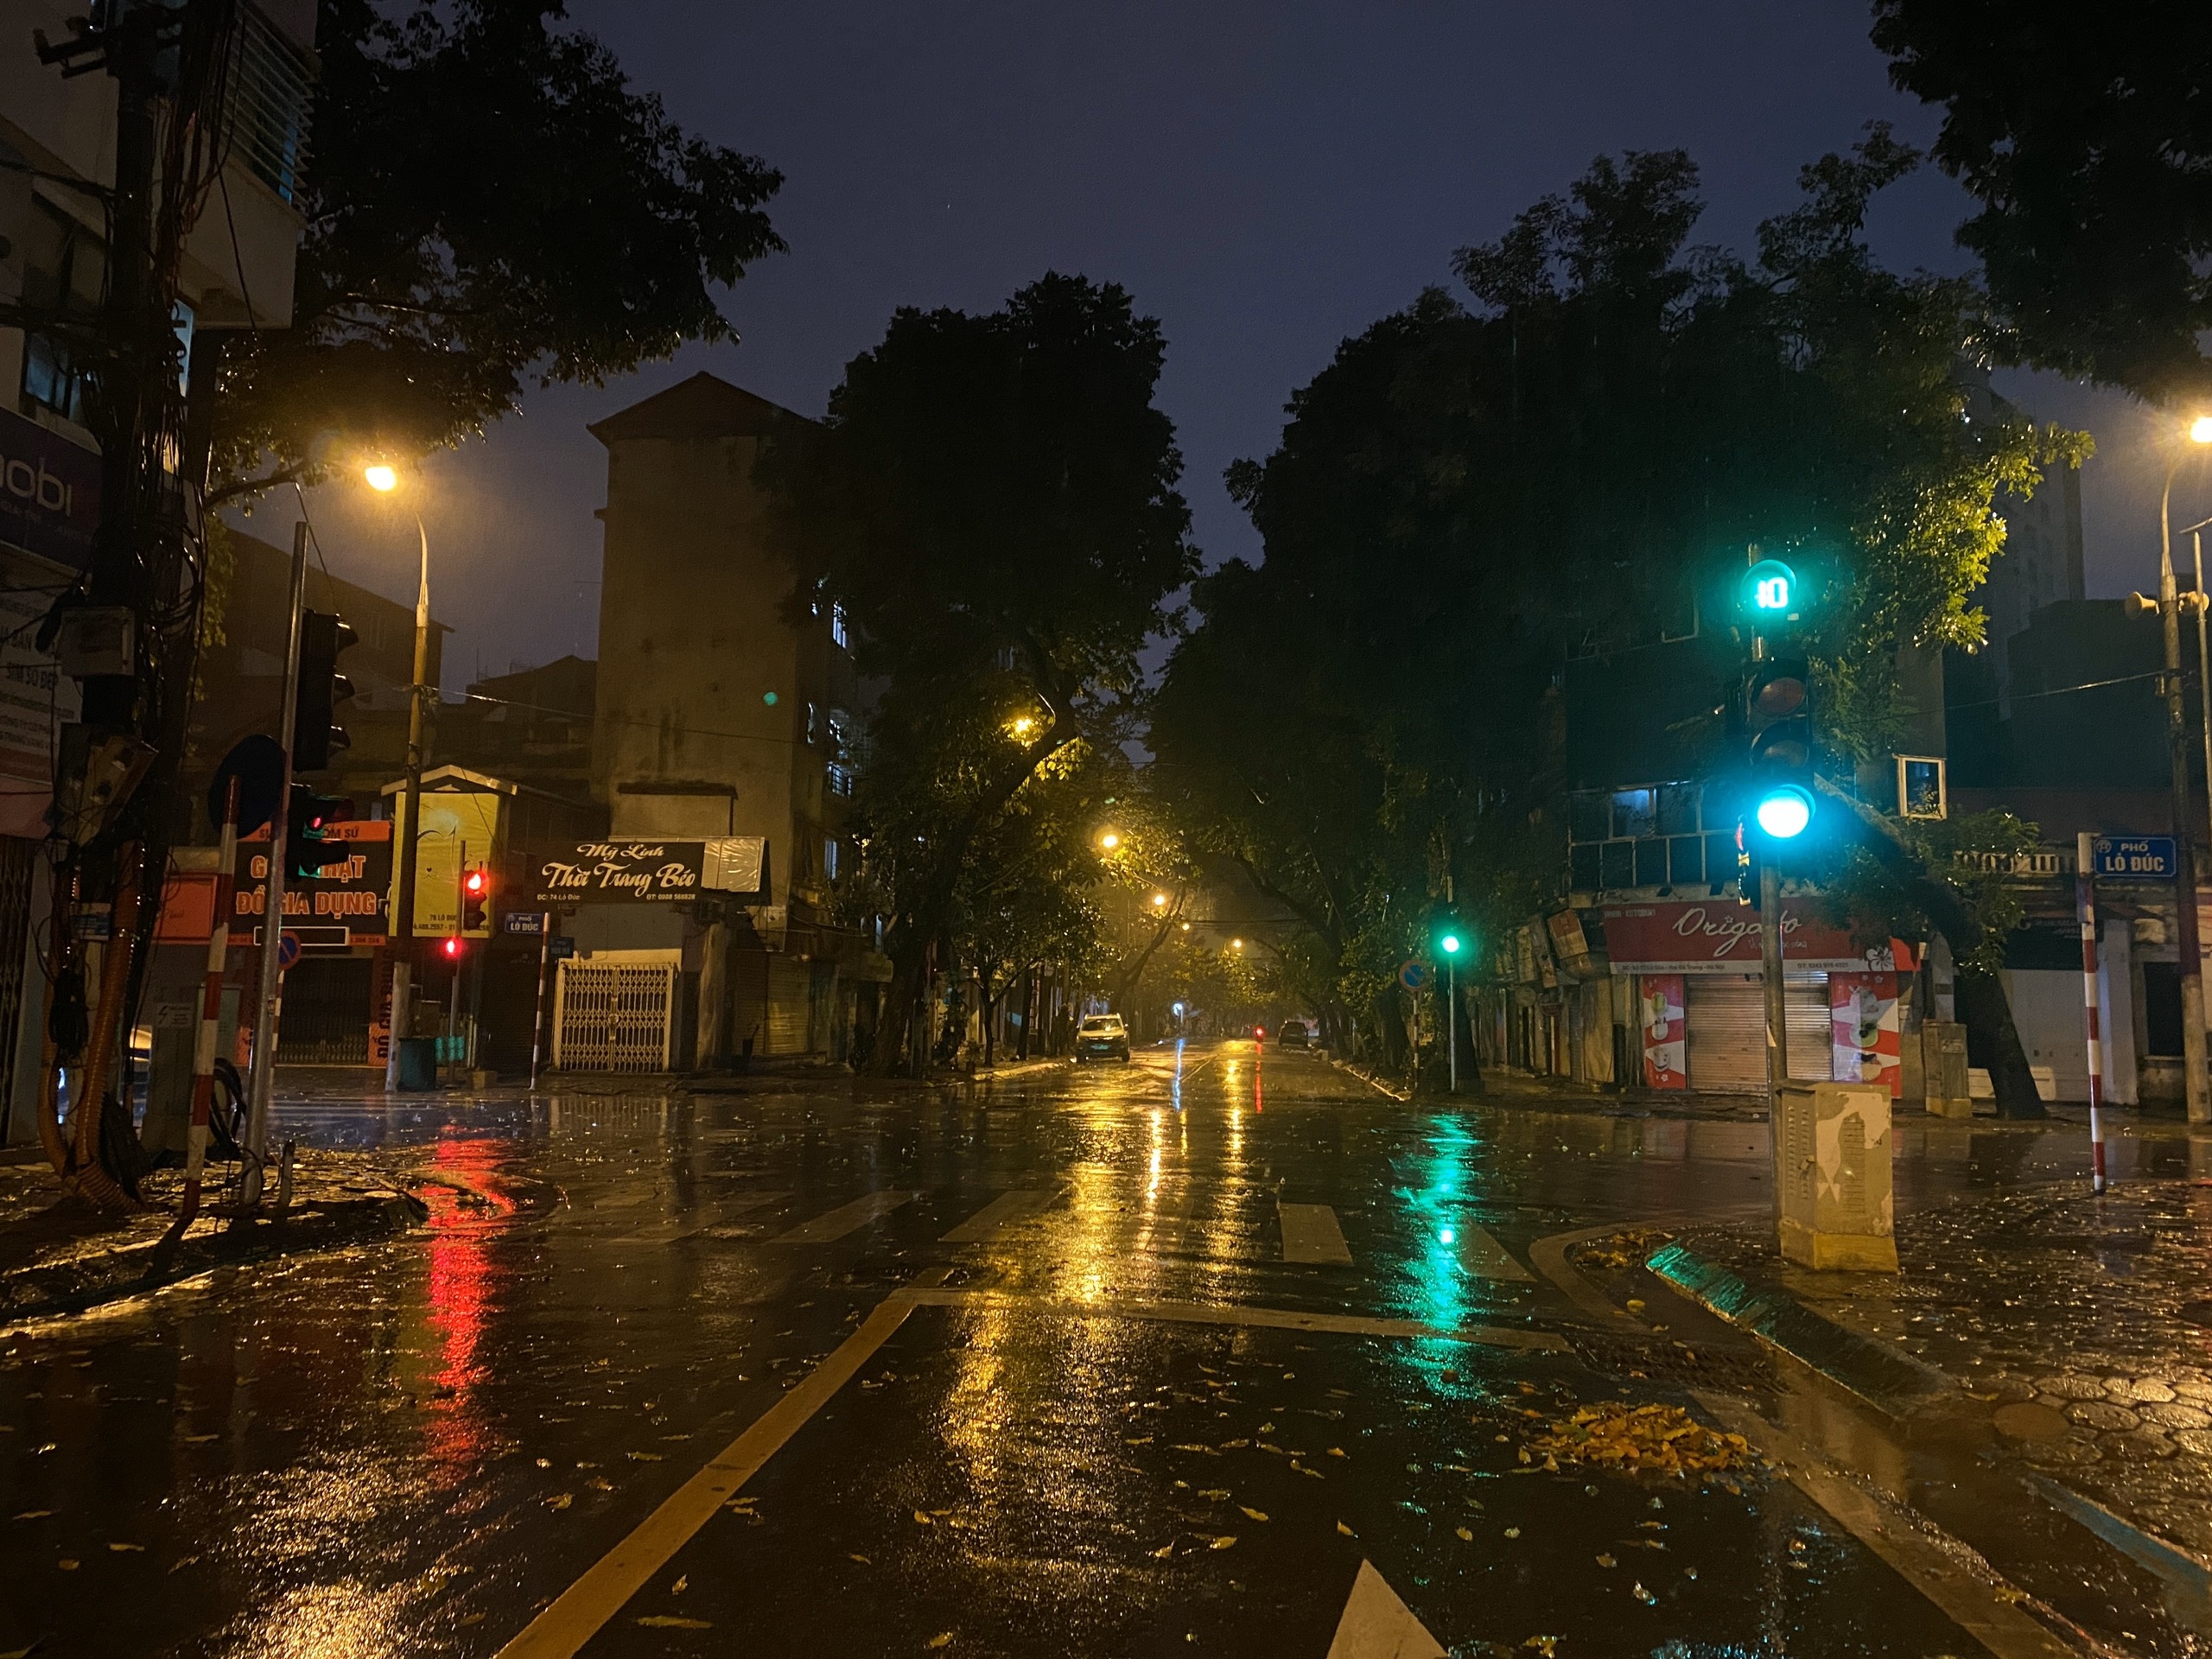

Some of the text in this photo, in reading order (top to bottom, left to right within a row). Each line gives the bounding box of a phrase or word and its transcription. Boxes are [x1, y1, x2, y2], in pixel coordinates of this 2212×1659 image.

[0, 454, 72, 518] obi
[1758, 577, 1789, 608] 10
[576, 843, 665, 861] Mỹ Linh
[2120, 840, 2149, 852] PHỐ
[2105, 852, 2164, 872] LÒ ĐÚC
[593, 862, 652, 897] Trang
[656, 862, 696, 888] Béo
[315, 892, 378, 919] DỤNG
